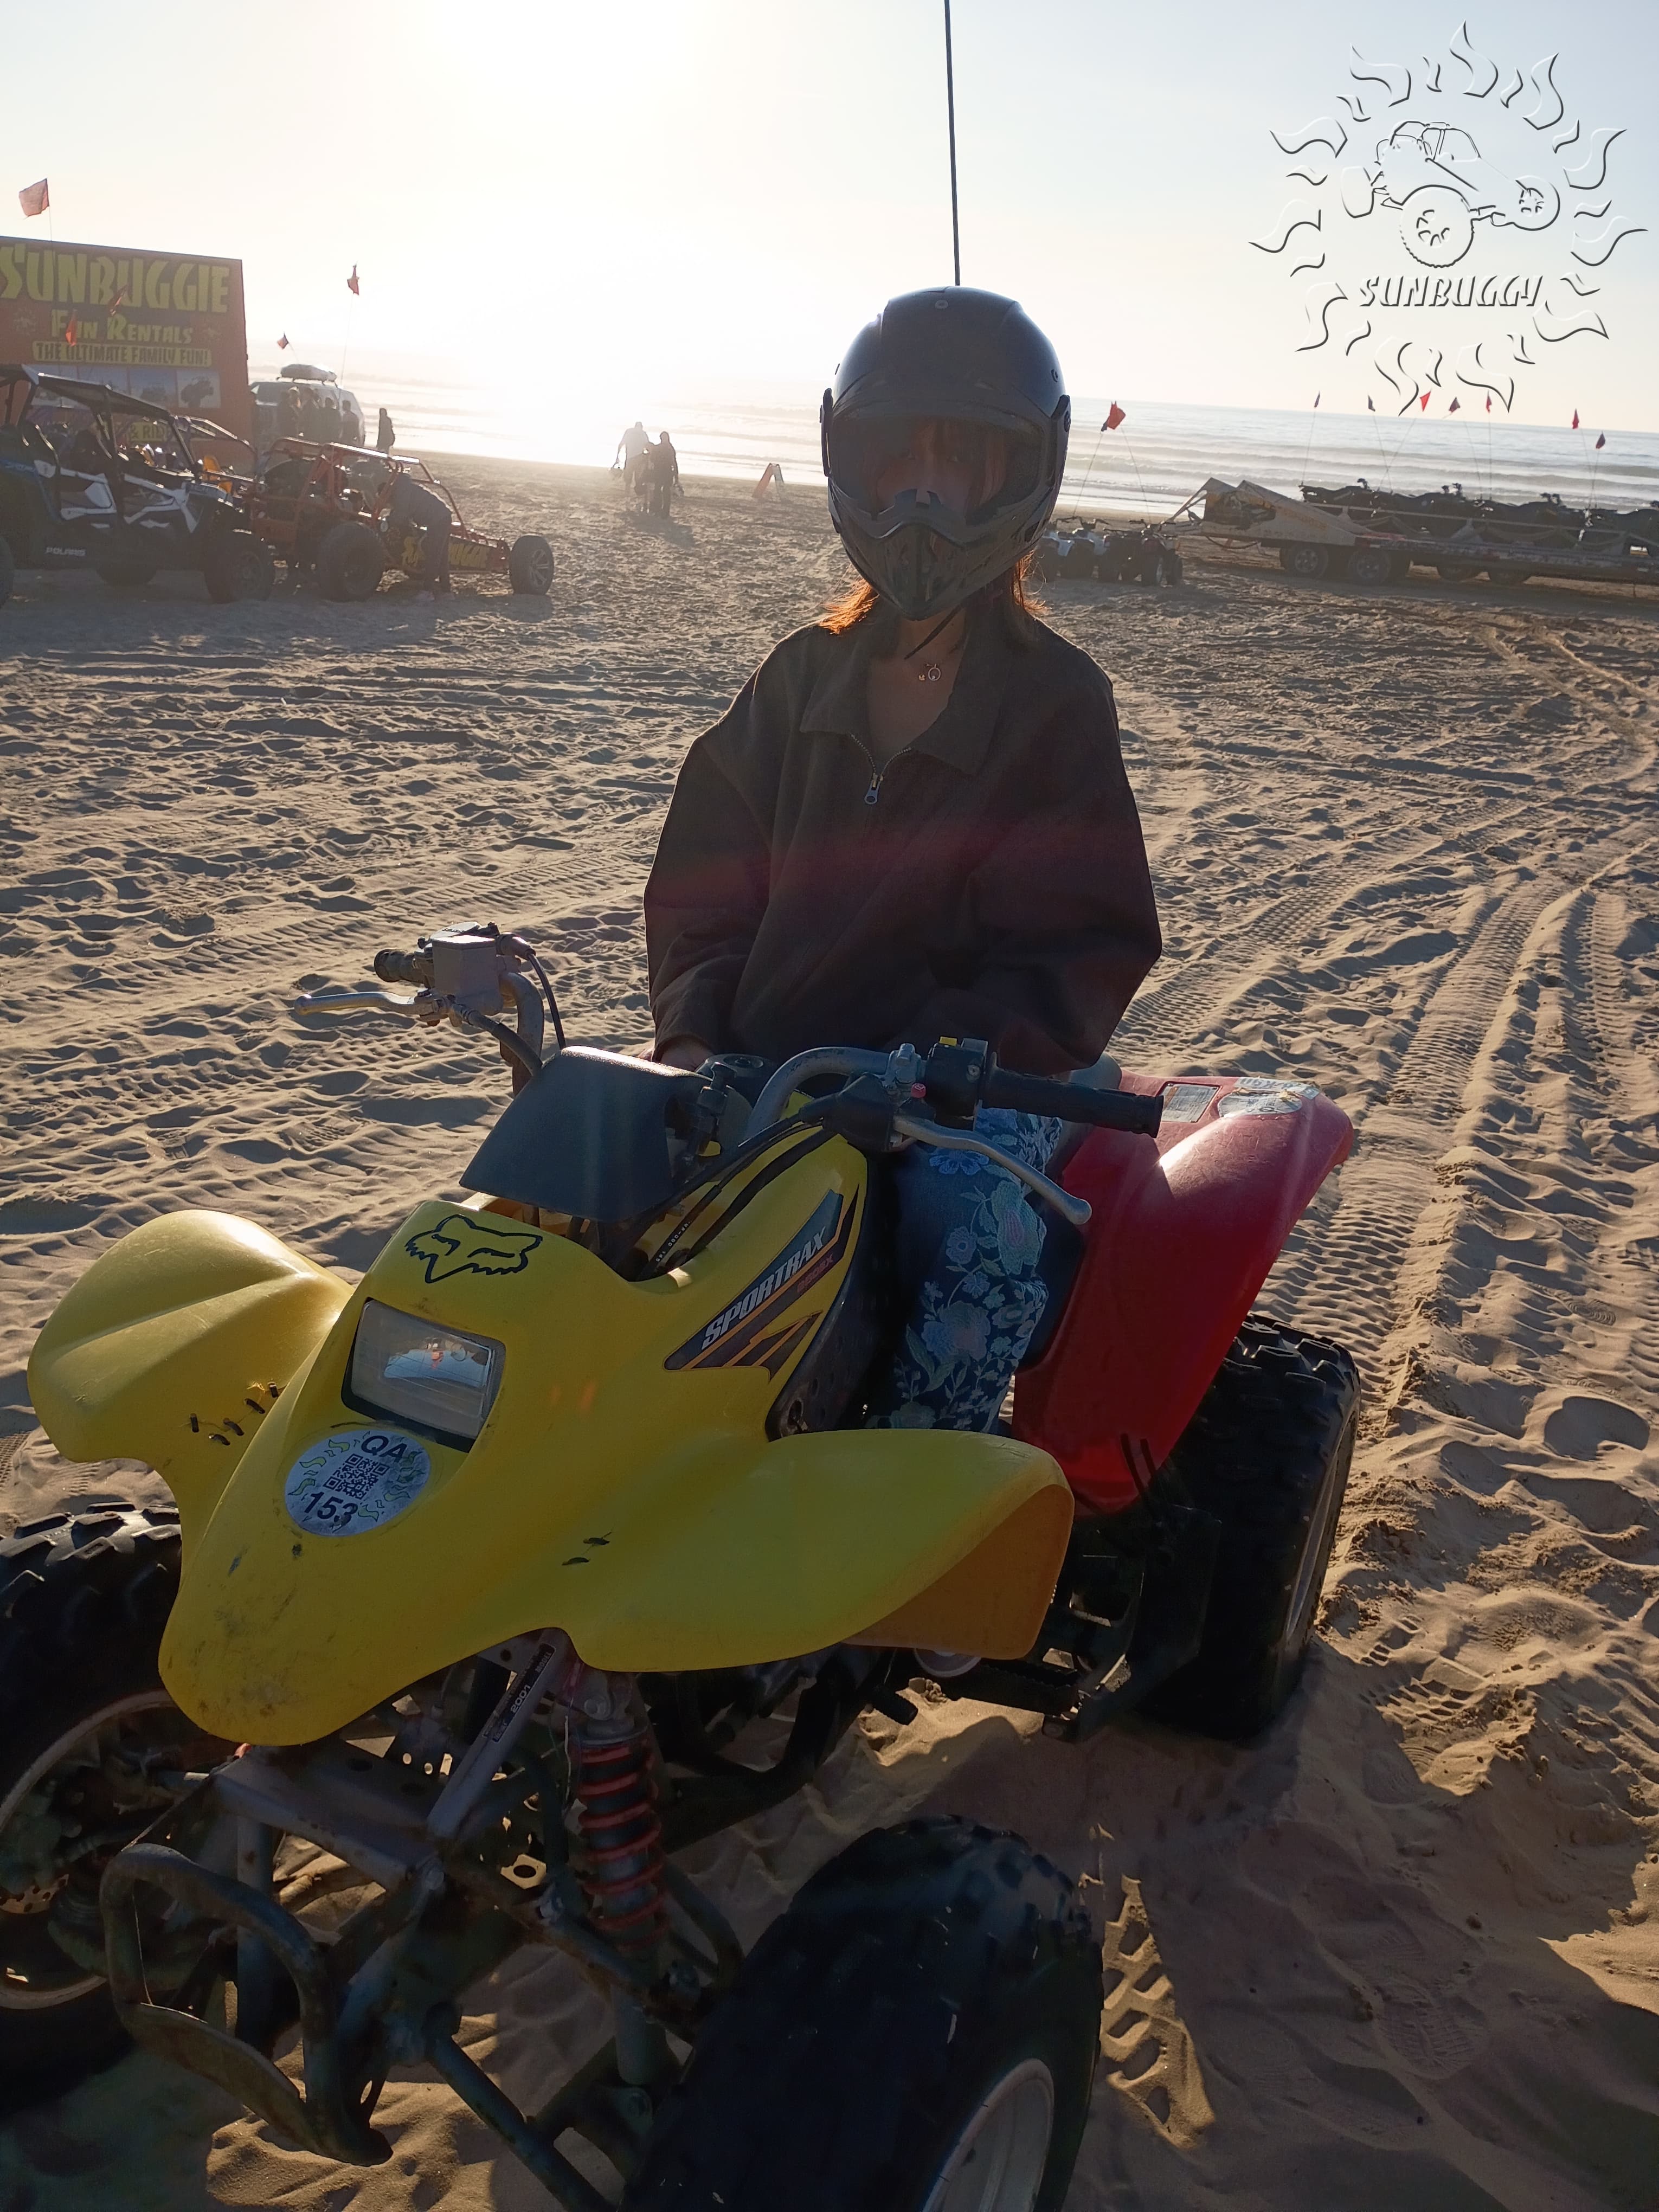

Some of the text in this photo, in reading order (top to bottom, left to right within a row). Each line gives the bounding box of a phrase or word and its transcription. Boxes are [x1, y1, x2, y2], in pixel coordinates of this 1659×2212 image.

[107, 313, 194, 344] RENTALS
[36, 342, 209, 365] THE ULTIMATE FAMILY FUN!
[44, 546, 86, 556] POLARIS
[701, 1227, 827, 1351] SPORTRAX
[361, 1435, 408, 1463] QA
[304, 1491, 358, 1527] 153
[511, 1683, 532, 1714] 2001
